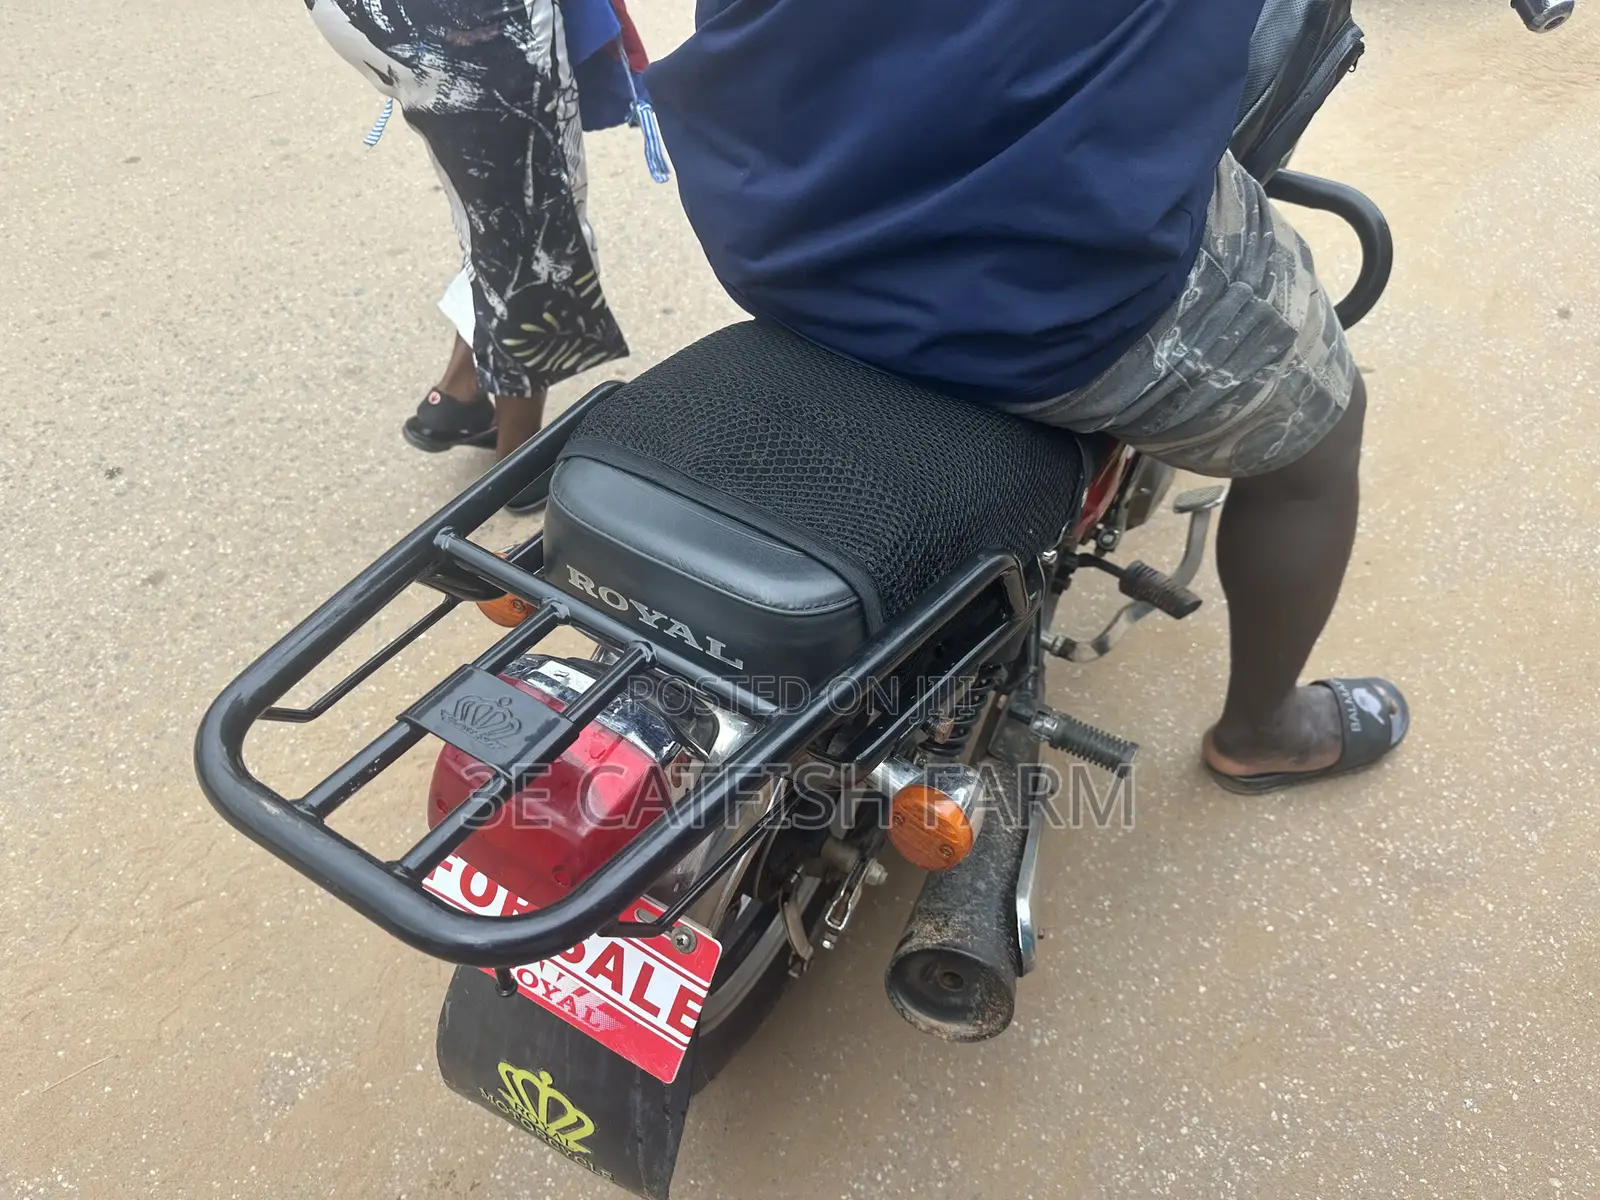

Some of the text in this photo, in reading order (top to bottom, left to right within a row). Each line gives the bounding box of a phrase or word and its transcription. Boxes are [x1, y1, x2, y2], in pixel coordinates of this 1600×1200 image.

[566, 564, 744, 670] ROYAL
[516, 967, 601, 1029] OYAL
[479, 1086, 616, 1182] MOTORCYCLE
[514, 1102, 576, 1151] ROYAL
